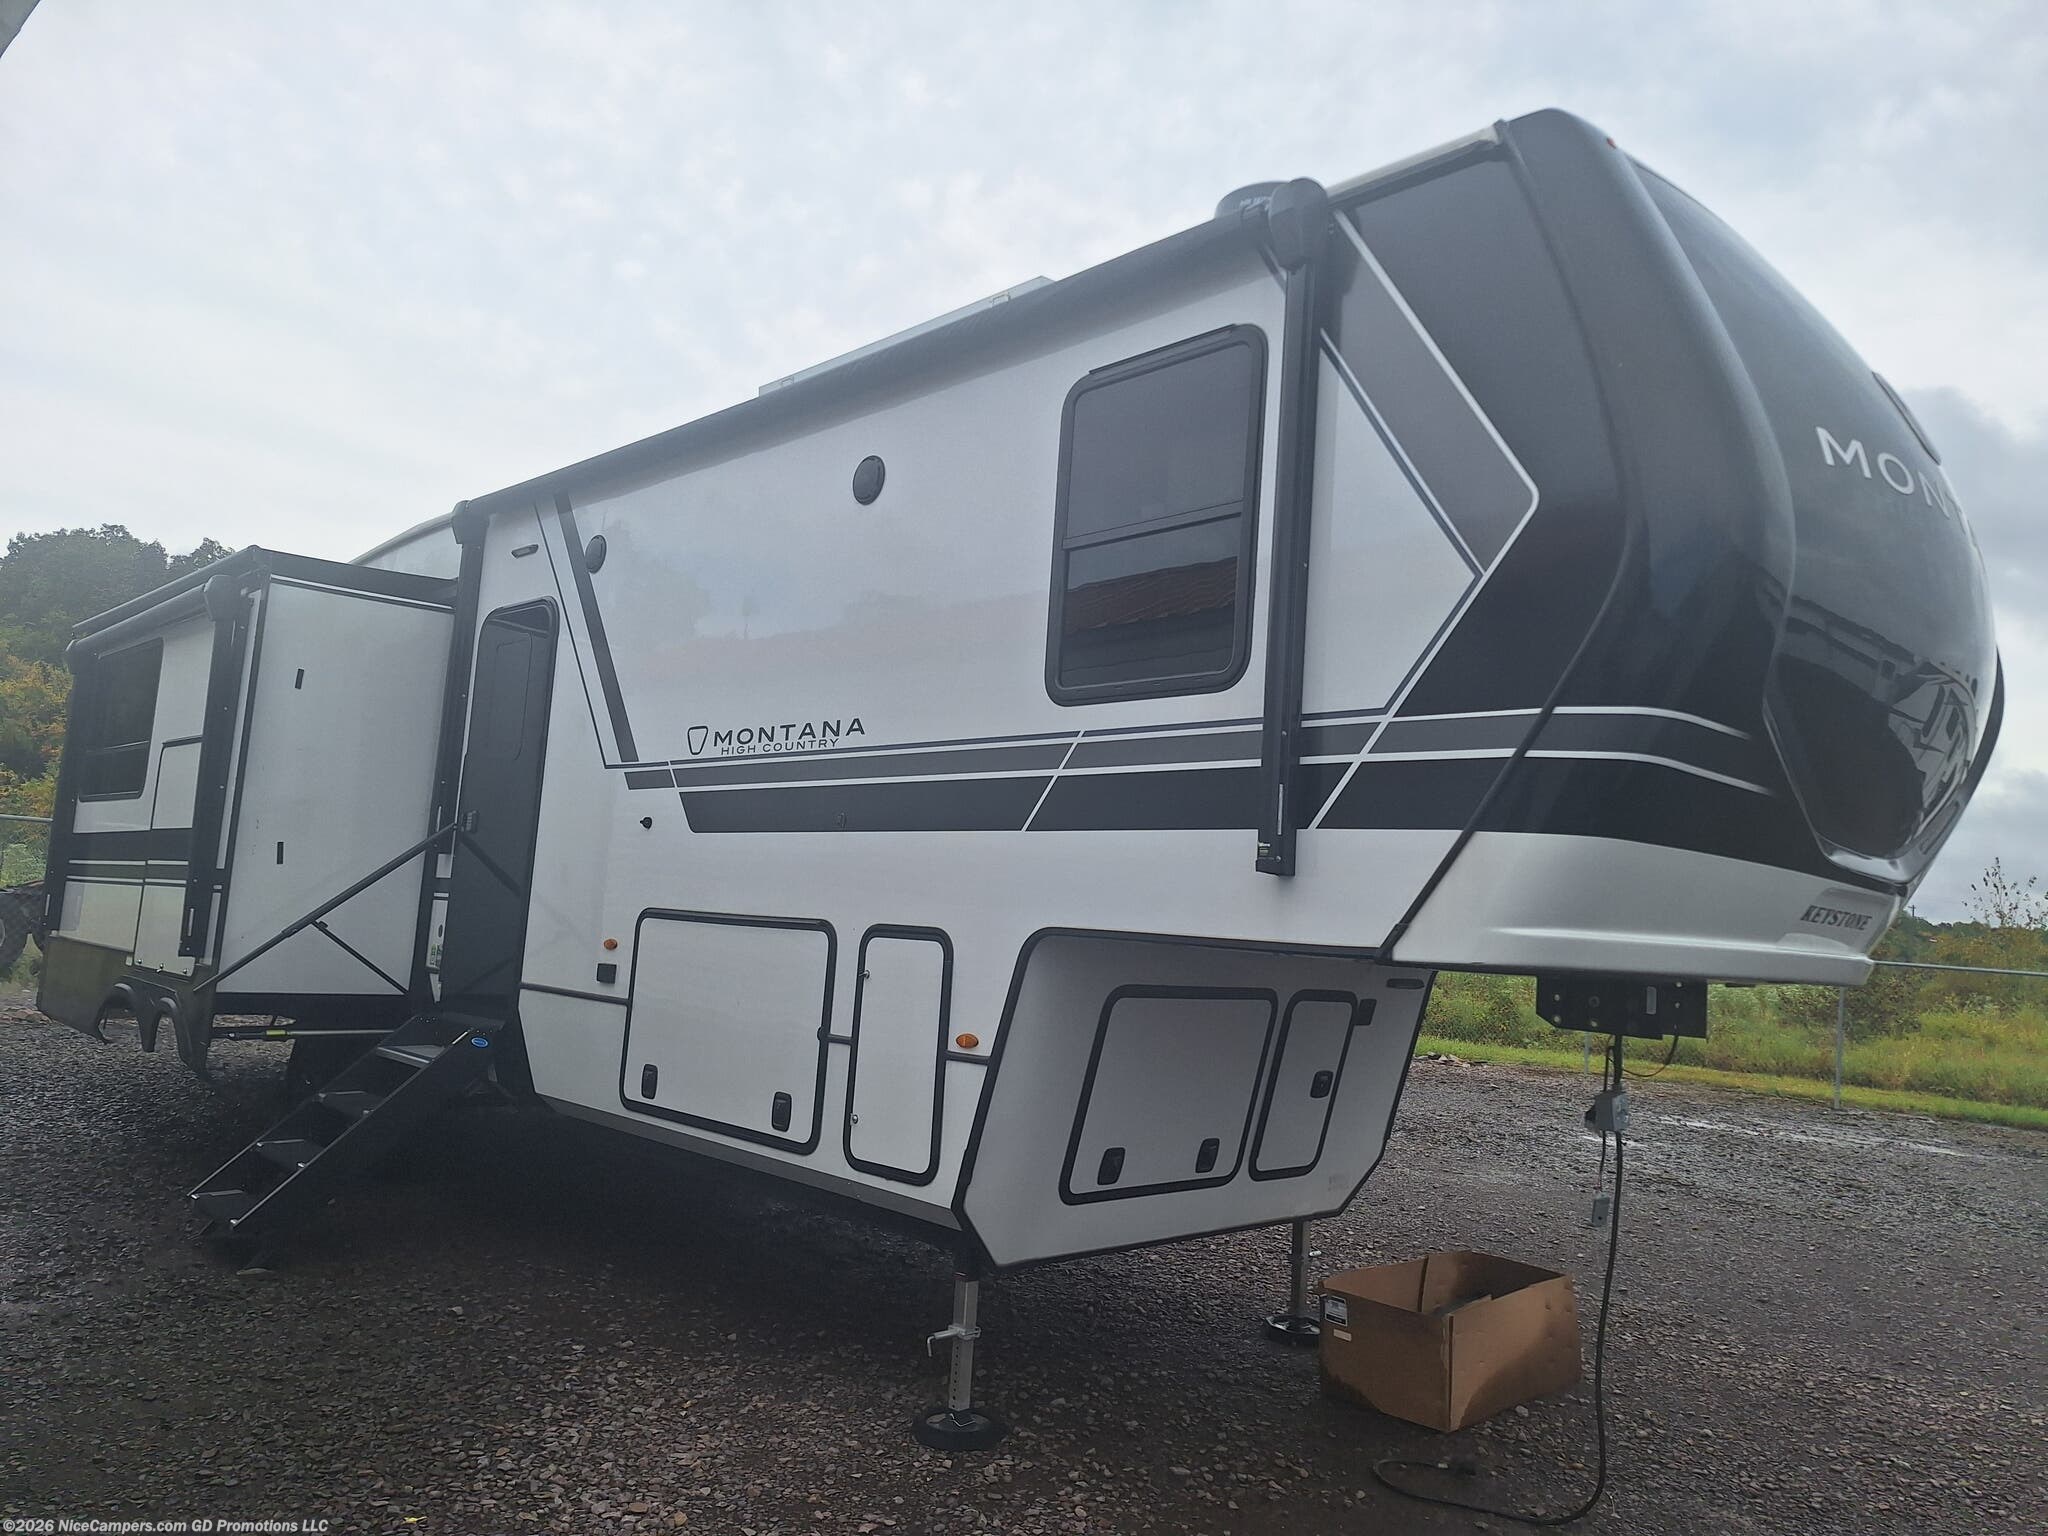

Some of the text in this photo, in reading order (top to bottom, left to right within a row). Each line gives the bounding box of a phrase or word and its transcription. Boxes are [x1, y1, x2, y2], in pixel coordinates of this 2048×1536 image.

[713, 718, 865, 747] MONTANA
[721, 738, 839, 756] HIGH COUNTRY
[1801, 905, 1872, 930] KEYSTONE
